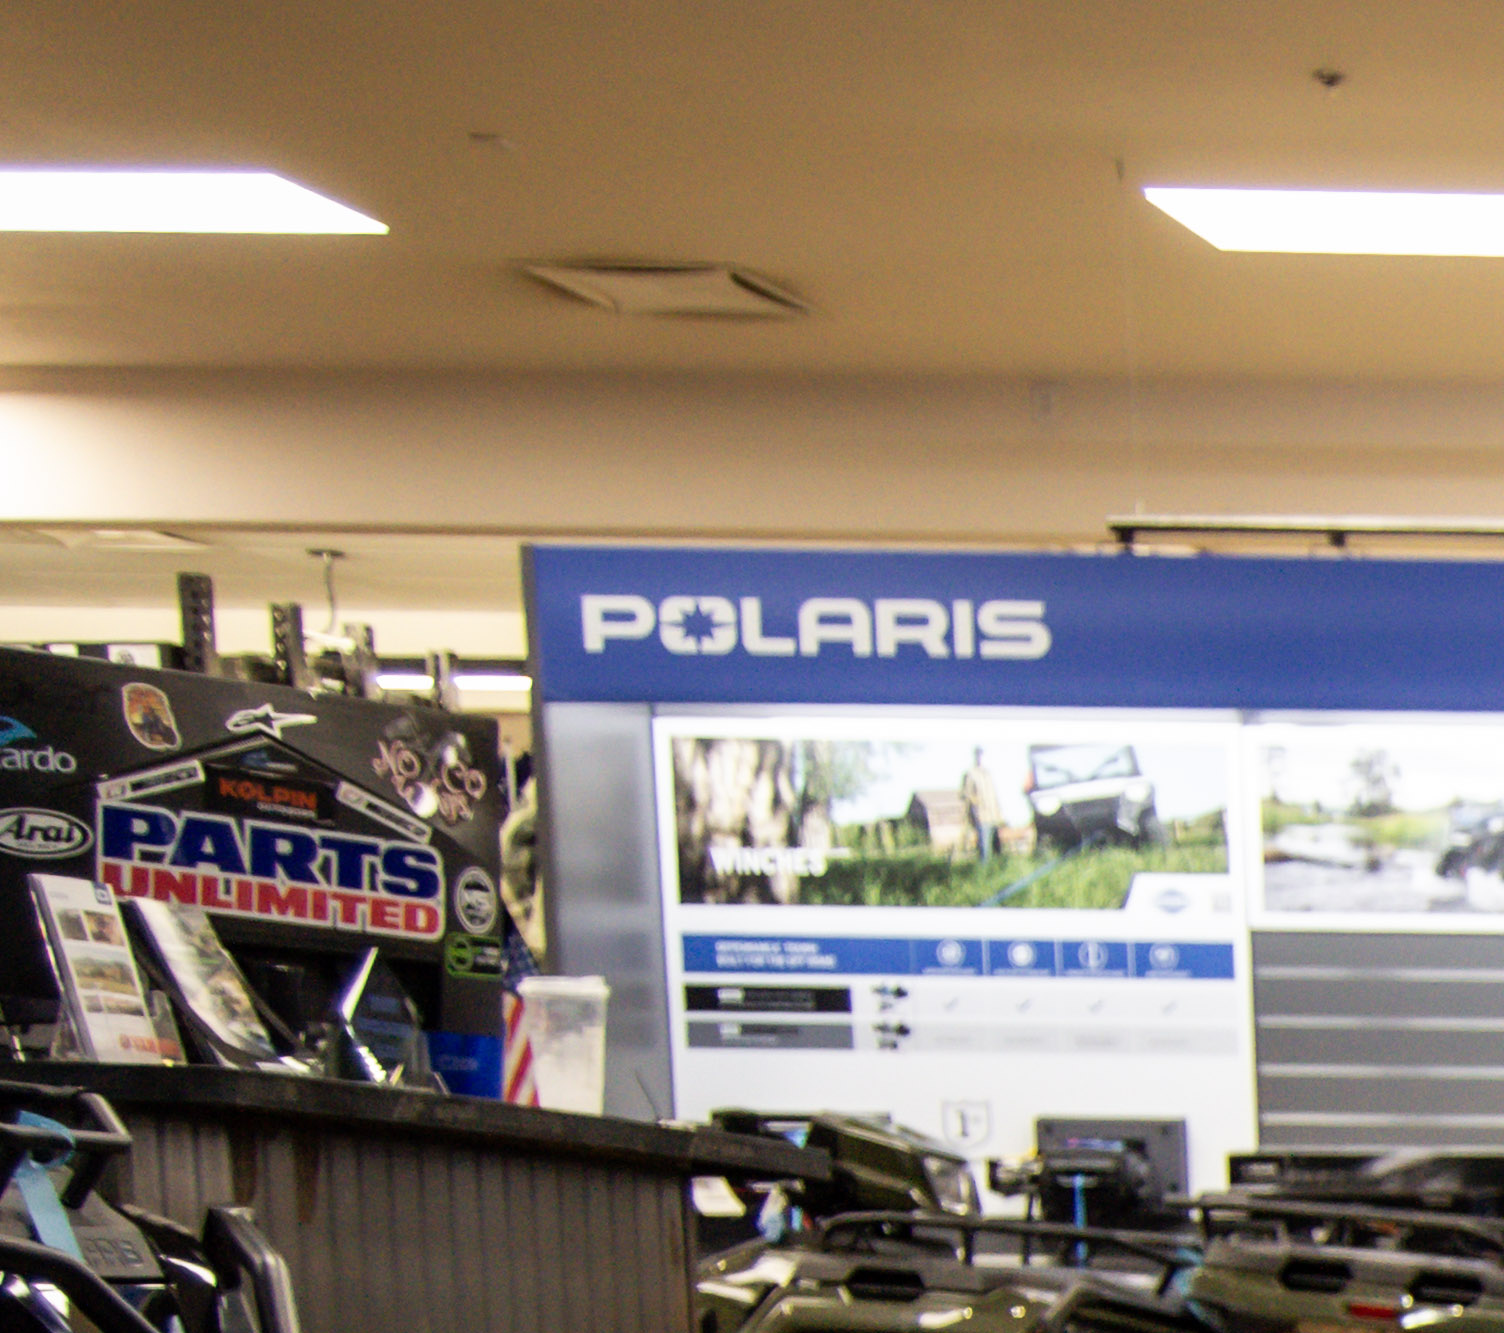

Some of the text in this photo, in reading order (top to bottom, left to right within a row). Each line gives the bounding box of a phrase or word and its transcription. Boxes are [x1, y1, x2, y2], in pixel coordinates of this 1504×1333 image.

[580, 594, 1053, 661] POLARIS
[0, 812, 77, 843] Arai
[101, 803, 442, 899] PARTS
[102, 862, 442, 937] UNLIMITED
